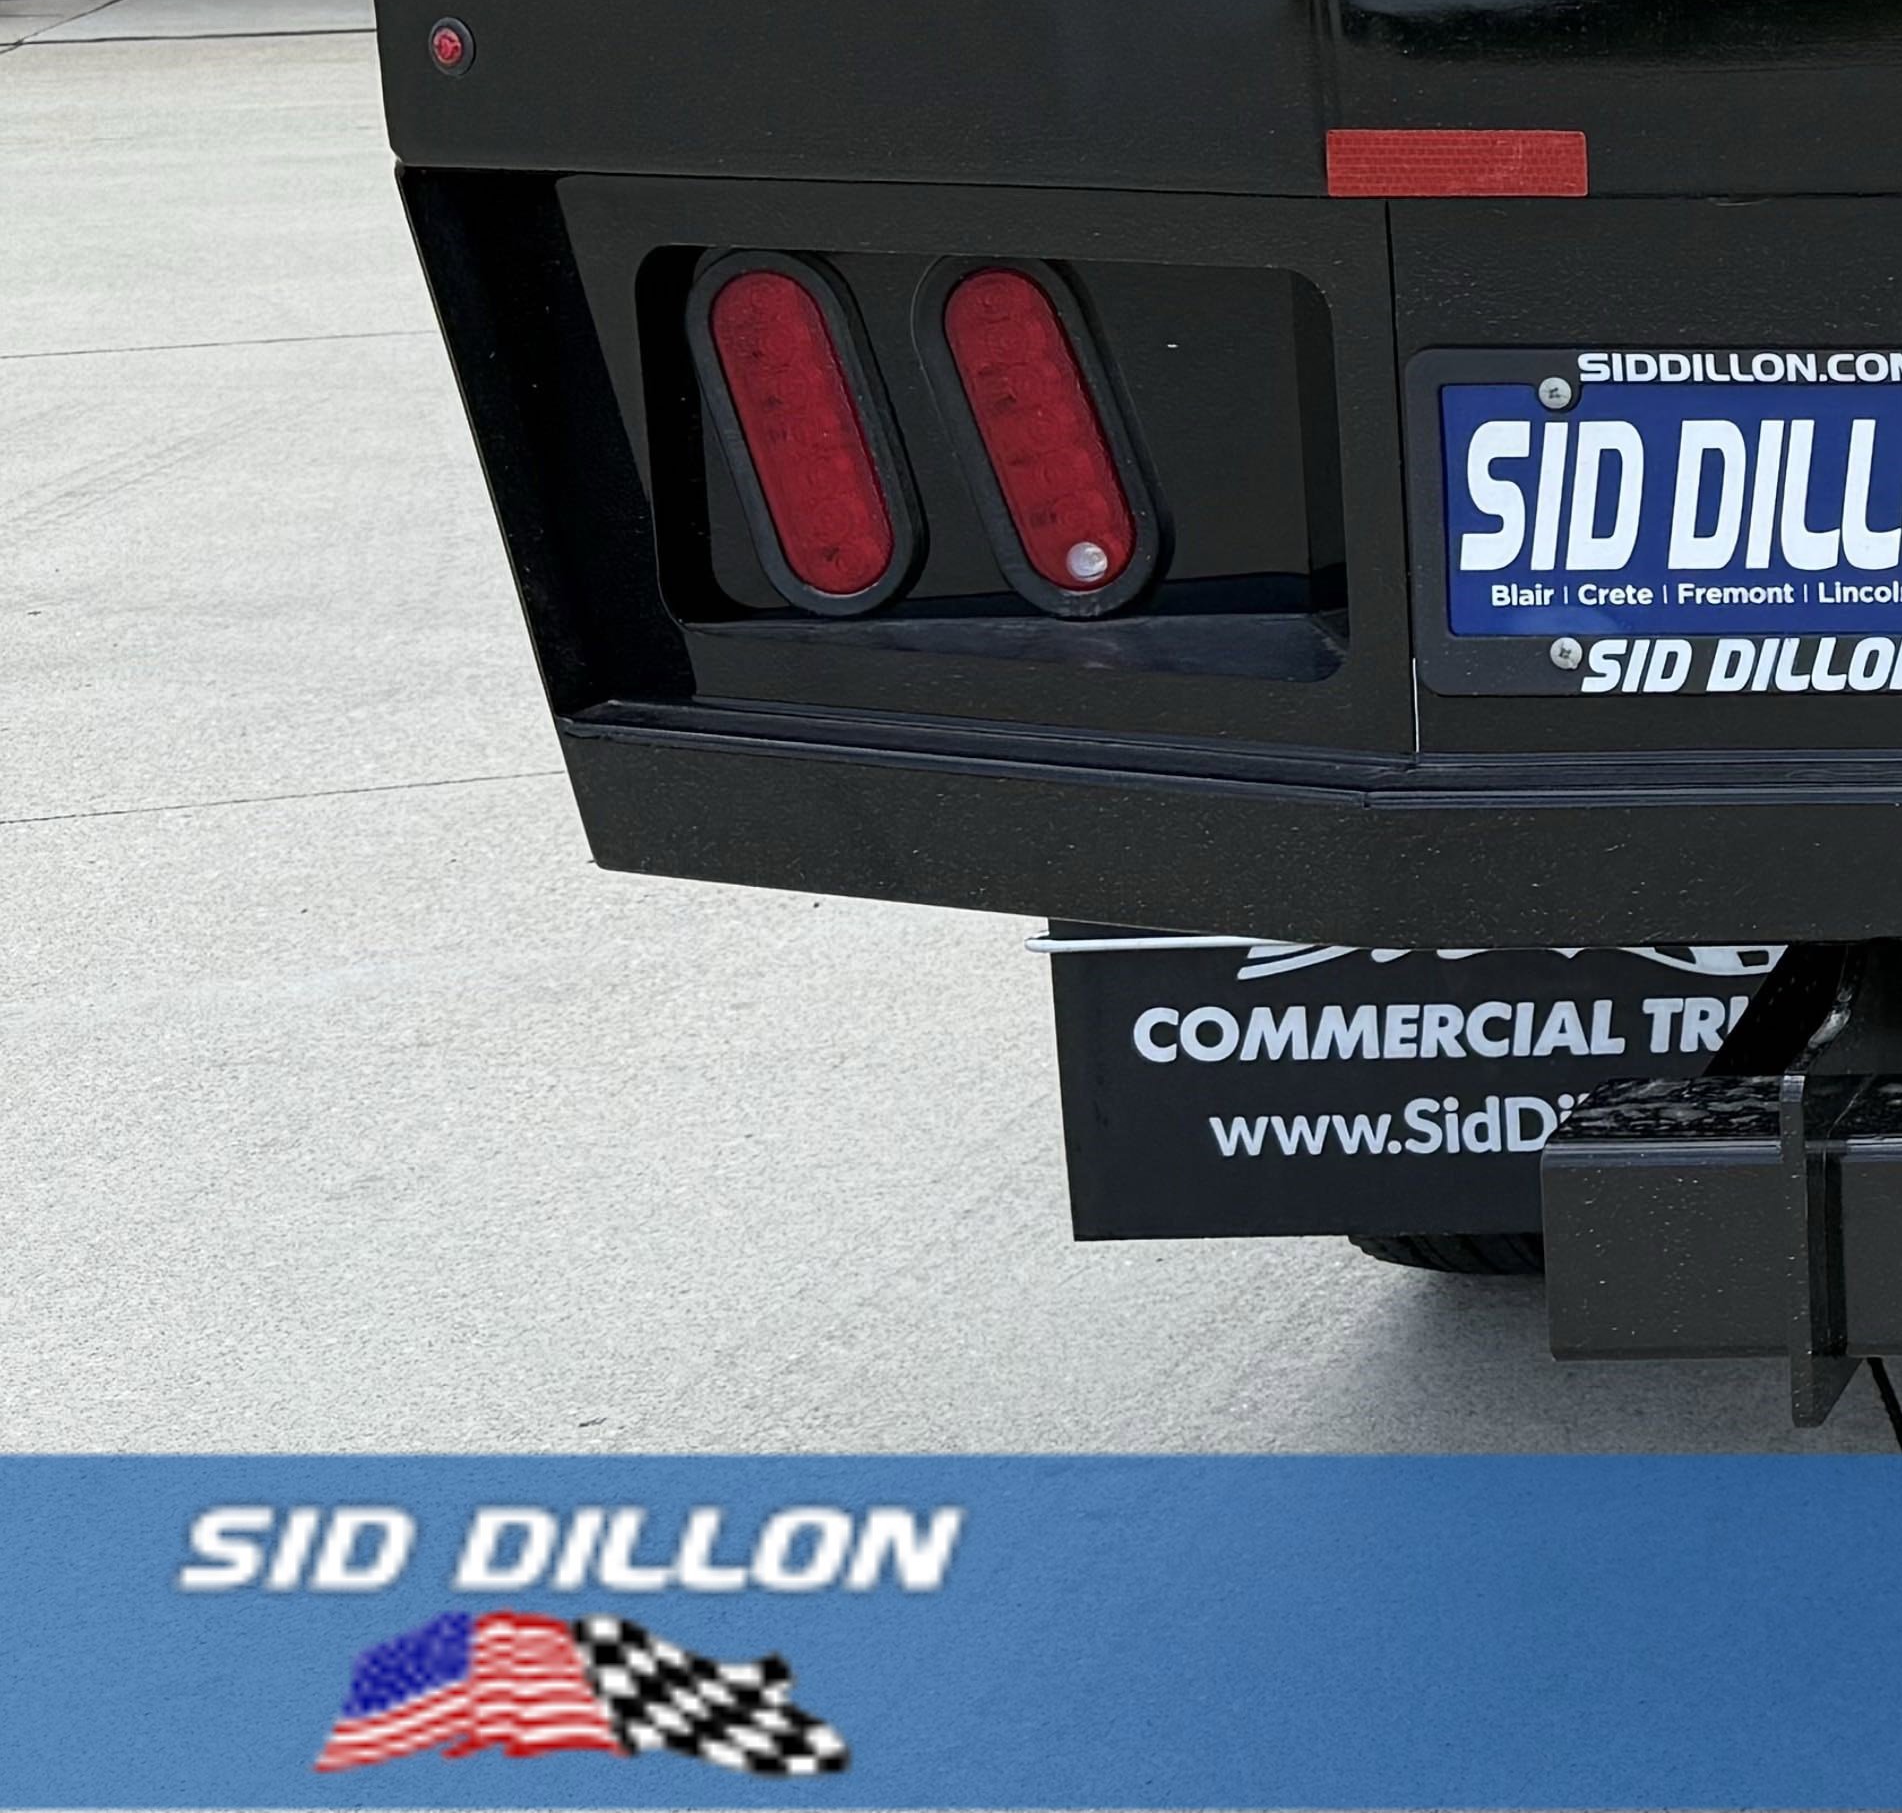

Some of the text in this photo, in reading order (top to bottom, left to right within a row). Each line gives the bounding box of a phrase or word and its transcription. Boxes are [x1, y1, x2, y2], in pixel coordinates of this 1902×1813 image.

[1460, 419, 1645, 572] SID
[1491, 583, 1555, 607] Blair
[1577, 583, 1654, 606] Crete
[1677, 582, 1795, 605] Fremont
[1580, 638, 1692, 693] SID
[1133, 999, 1626, 1063] COMMERCIAL
